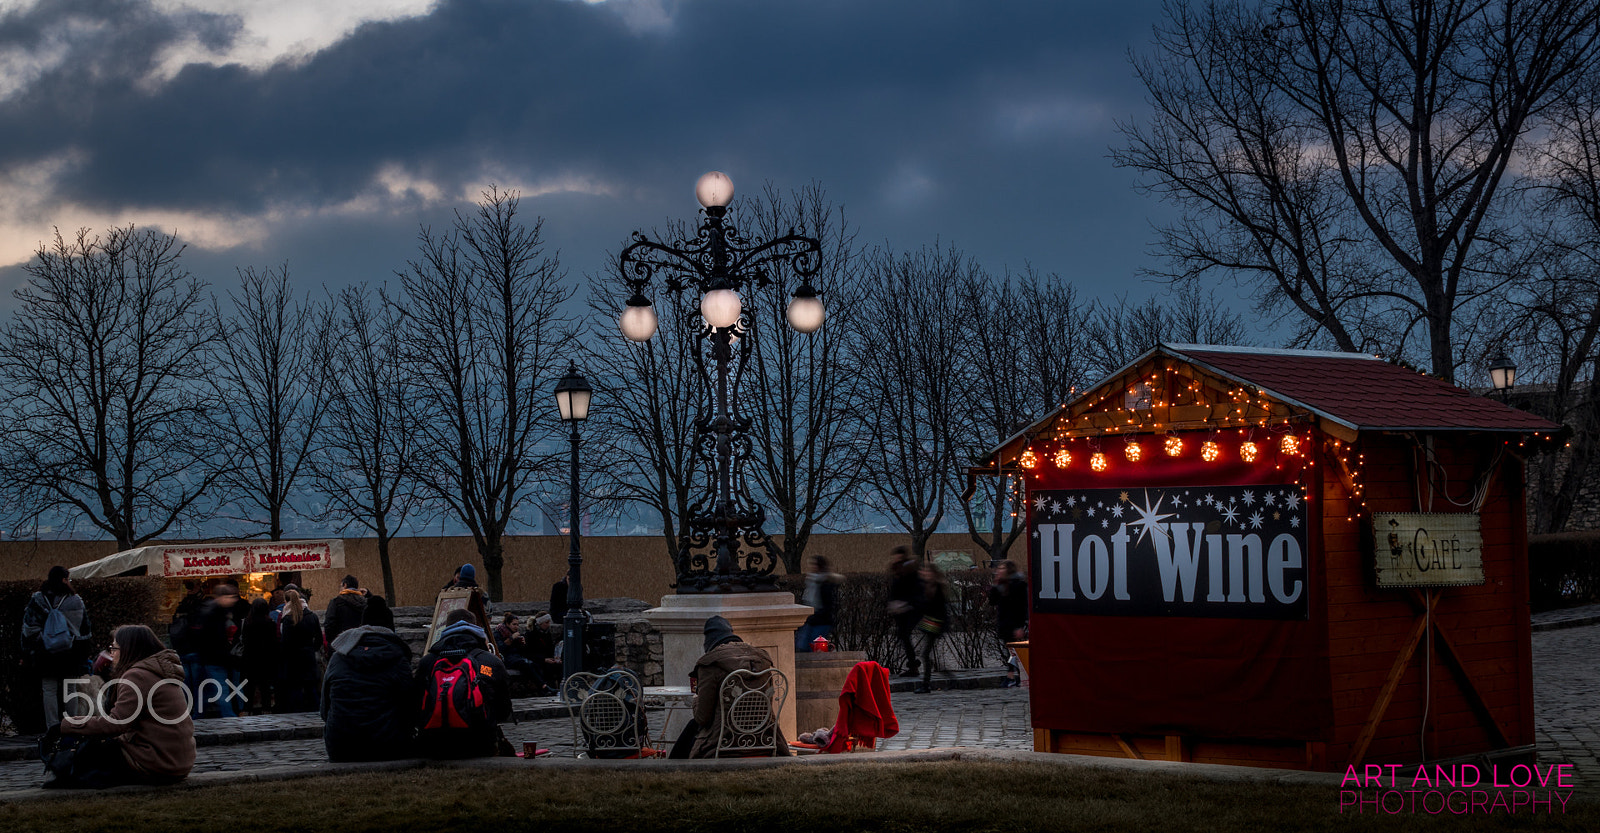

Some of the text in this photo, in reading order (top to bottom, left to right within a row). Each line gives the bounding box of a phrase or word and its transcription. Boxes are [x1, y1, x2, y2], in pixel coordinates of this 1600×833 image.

[1037, 522, 1303, 604] Hot Wine
[1413, 527, 1462, 573] CAFÉ
